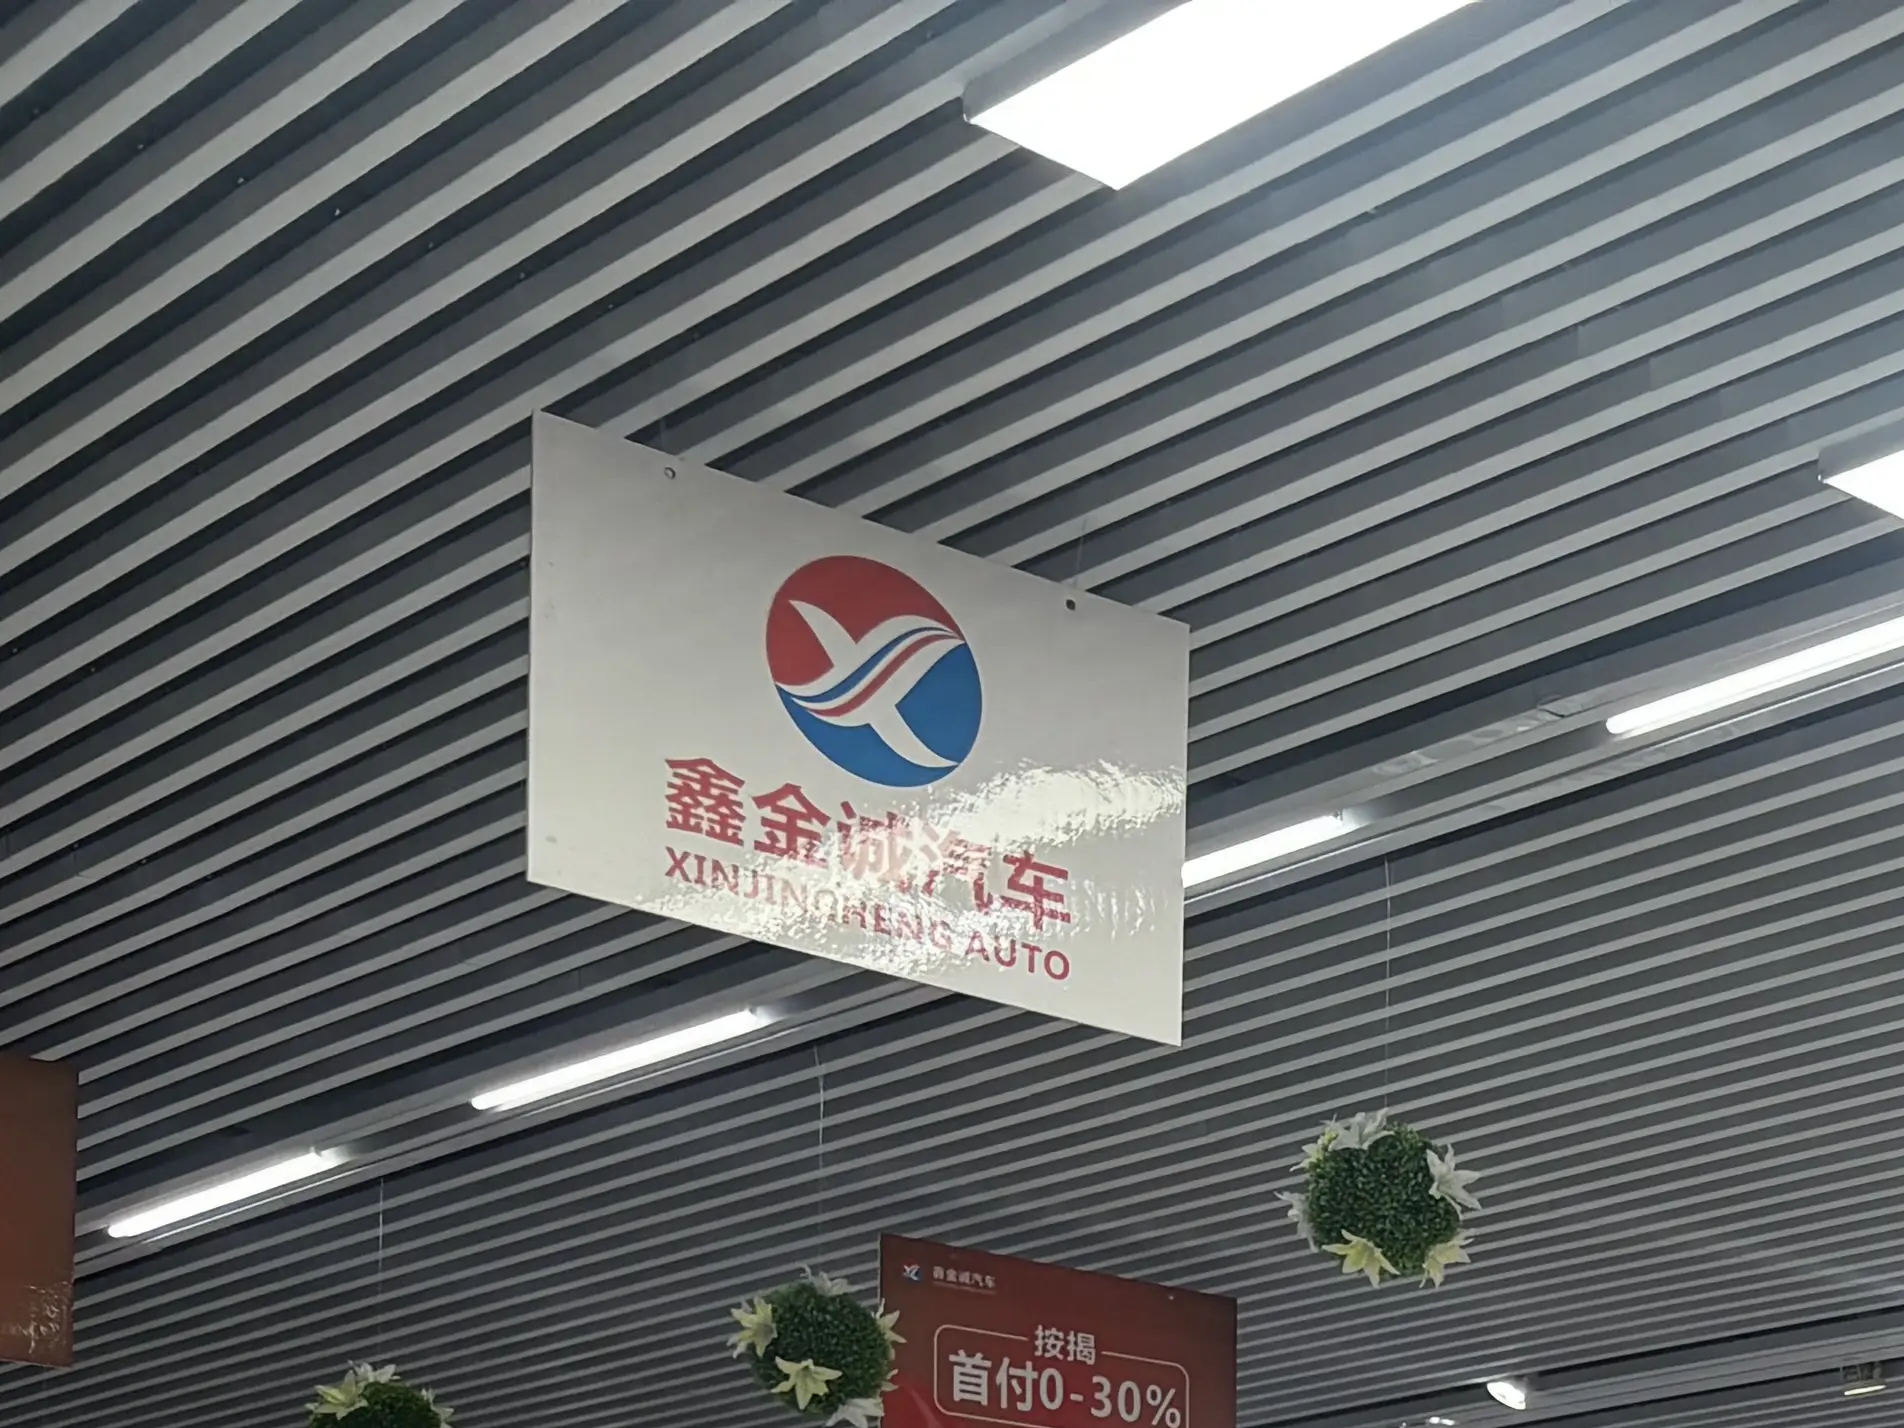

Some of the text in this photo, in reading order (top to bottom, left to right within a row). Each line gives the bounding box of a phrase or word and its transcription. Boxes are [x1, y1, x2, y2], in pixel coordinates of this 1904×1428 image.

[664, 758, 1071, 932] 鑫金诚汽车
[965, 930, 1071, 980] AUTO
[1034, 1325, 1096, 1365] 按揭
